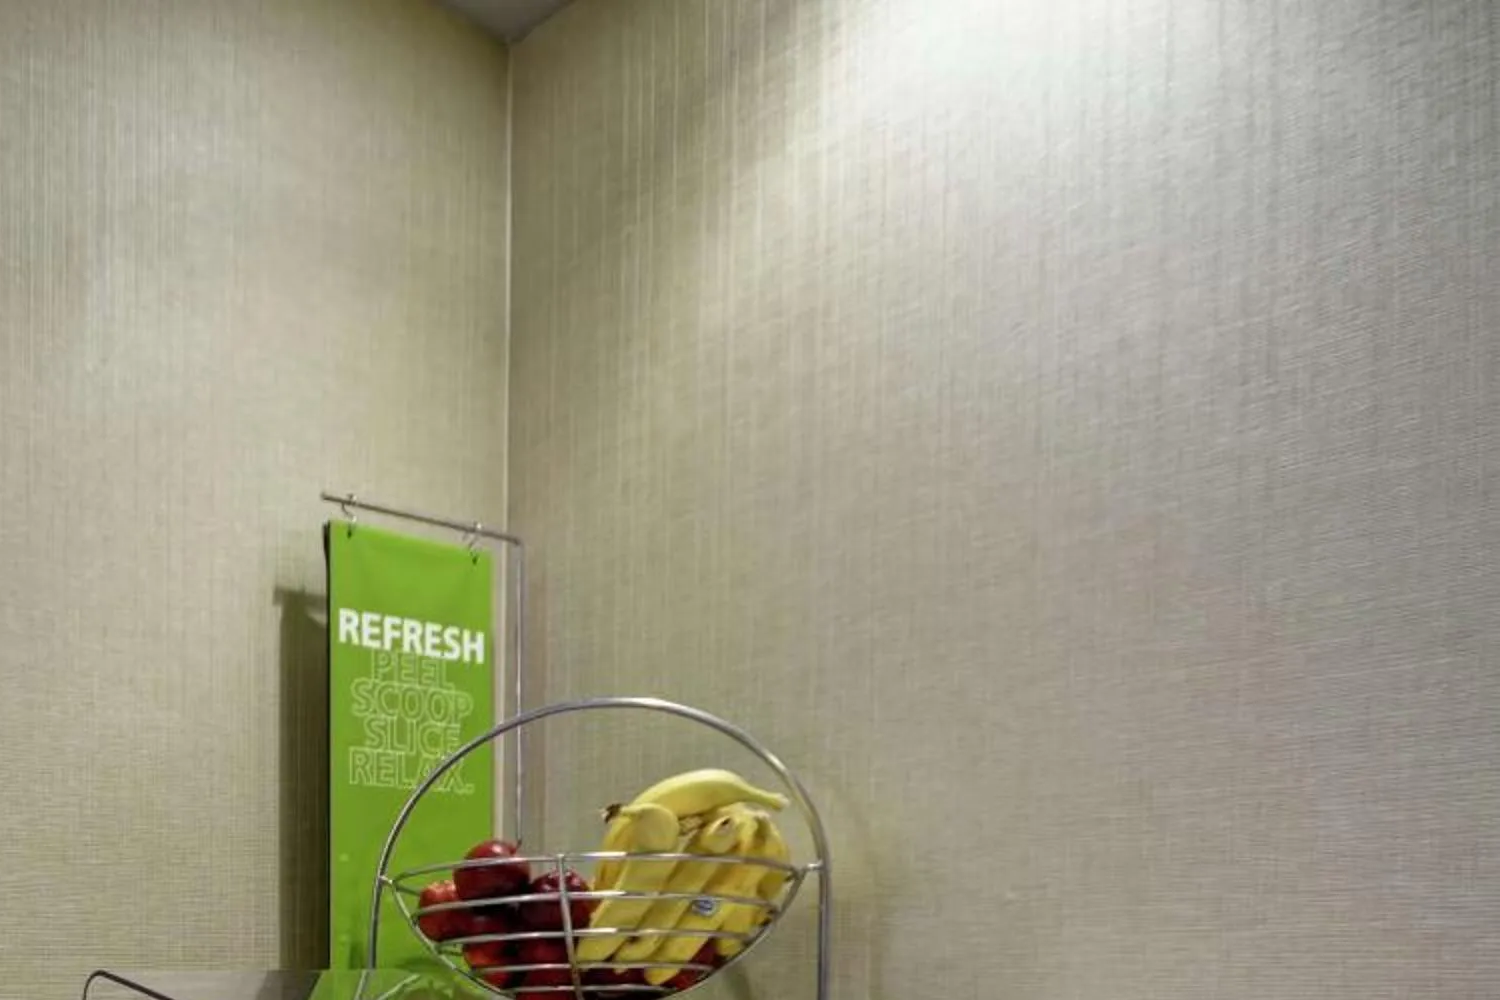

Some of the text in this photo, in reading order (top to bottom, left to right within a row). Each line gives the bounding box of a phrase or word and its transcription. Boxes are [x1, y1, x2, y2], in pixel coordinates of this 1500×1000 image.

[339, 608, 485, 664] REFRESH
[371, 649, 455, 691] PEEL
[350, 677, 474, 725] SCOOP
[363, 714, 461, 757] SLICE
